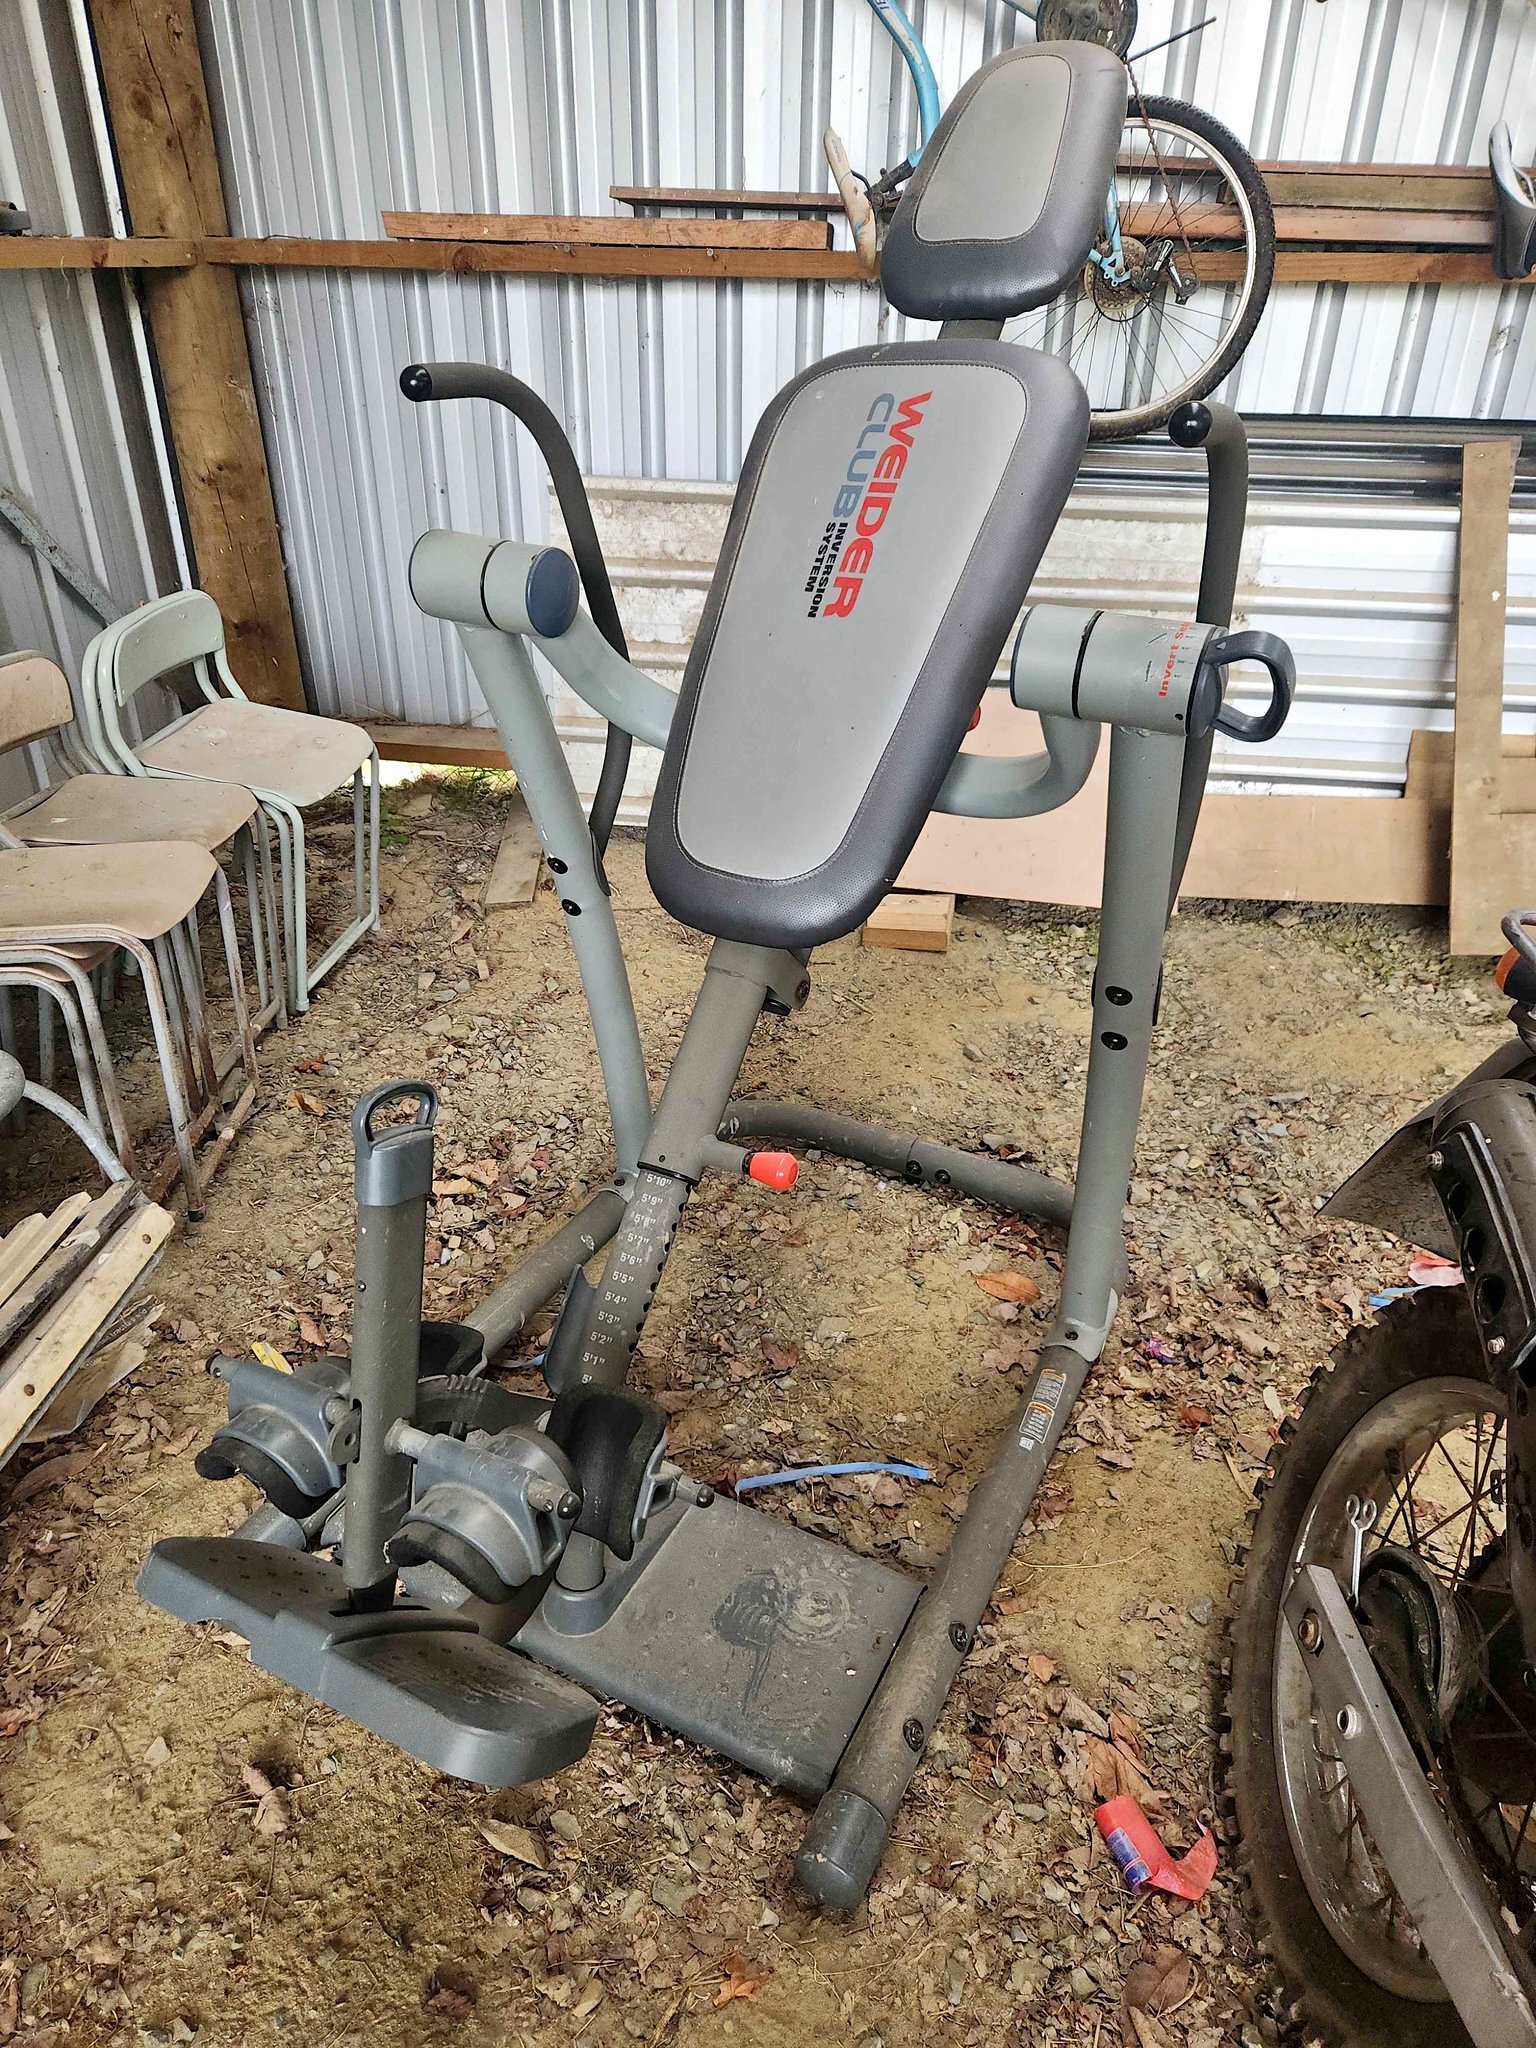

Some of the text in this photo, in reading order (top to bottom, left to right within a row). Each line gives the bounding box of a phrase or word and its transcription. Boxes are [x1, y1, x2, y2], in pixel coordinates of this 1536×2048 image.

[833, 393, 894, 518] CLUB
[823, 391, 933, 619] WEIDER
[804, 522, 836, 592] SYSTEM
[807, 522, 848, 618] INVERSION
[1158, 644, 1179, 697] Invert
